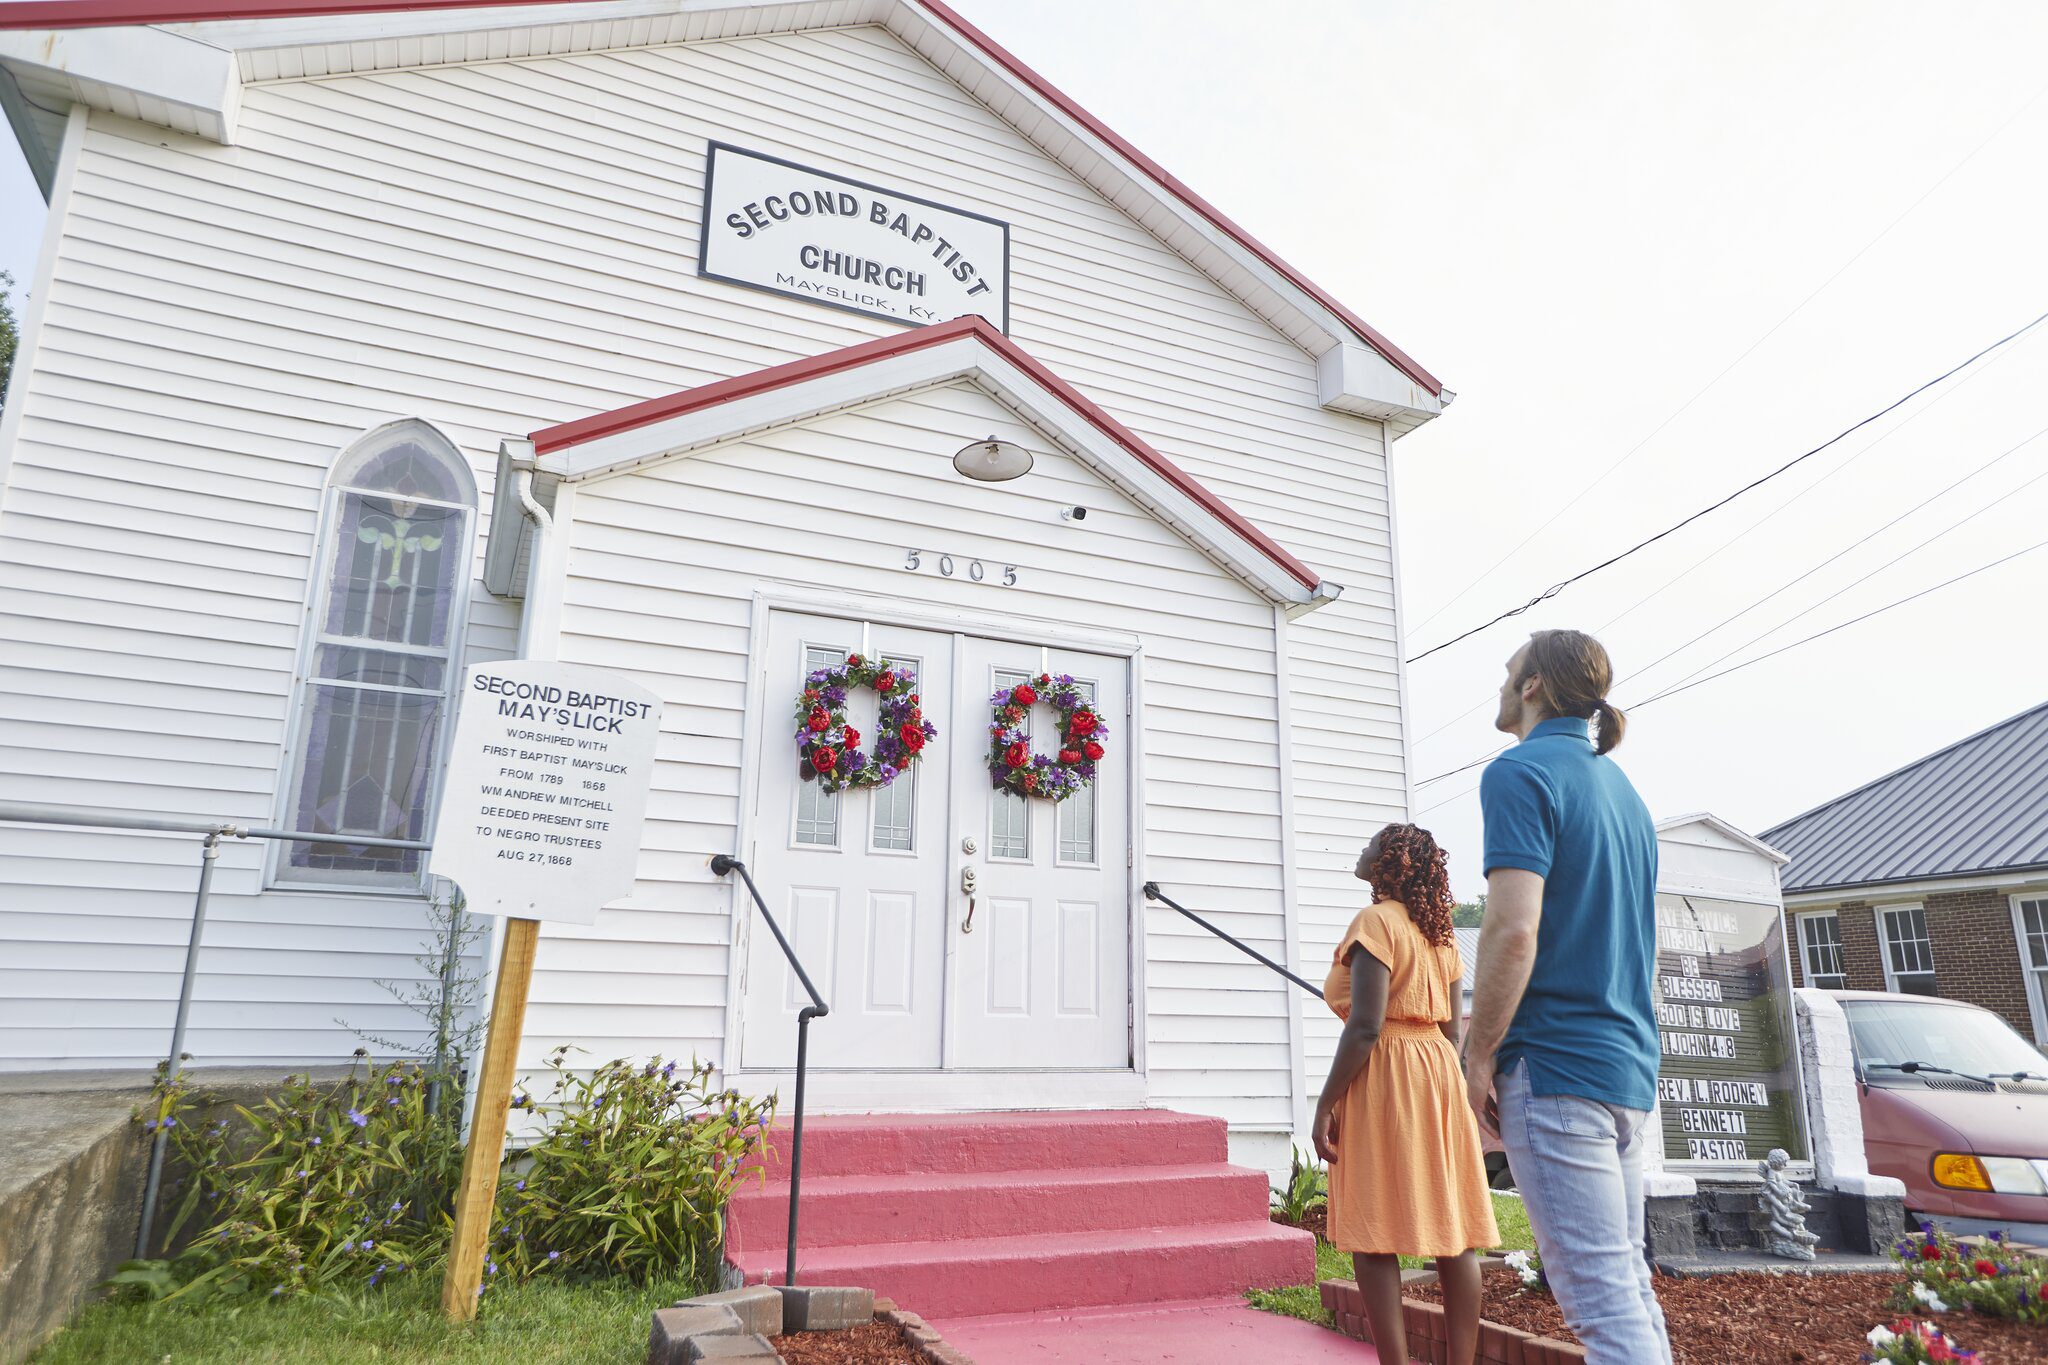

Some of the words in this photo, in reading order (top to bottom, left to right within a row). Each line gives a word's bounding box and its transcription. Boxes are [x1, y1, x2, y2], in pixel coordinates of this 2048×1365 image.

[726, 190, 860, 239] SECOND
[869, 200, 991, 299] BAPTIST
[800, 245, 926, 297] CHURCH
[776, 272, 896, 312] MAYSLICK,
[909, 304, 942, 322] KY.
[904, 549, 1018, 586] 5005
[473, 674, 562, 704] SECOND
[566, 691, 652, 720] BAPTIST
[506, 728, 575, 747] WORSHIPED
[578, 739, 608, 752] WITH
[482, 745, 517, 758] FIRST
[519, 750, 568, 766] BAPTIST
[499, 767, 534, 781] FROM
[540, 774, 564, 785] 1789
[582, 780, 606, 792] 1868
[481, 785, 503, 796] WM
[504, 788, 556, 803] ANDREW
[559, 796, 614, 812] MITCHELL
[480, 806, 530, 821] DEEDED
[532, 812, 583, 827] PRESENT
[585, 819, 610, 831] SITE
[476, 826, 492, 836] TO
[496, 828, 541, 842] NEGRO
[544, 834, 602, 850] TRUSTEES
[497, 849, 525, 861] AUG
[1682, 957, 1699, 977] BE
[1661, 976, 1721, 1001] BLESSED
[1658, 1004, 1686, 1026] GOD
[1689, 1006, 1703, 1027] IS
[1705, 1007, 1740, 1030] LOVE
[1672, 1033, 1708, 1056] JOHN
[1711, 1036, 1735, 1058] 4:8
[1657, 1079, 1690, 1101] REV.
[1695, 1080, 1709, 1102] L.
[1712, 1081, 1766, 1105] RODNEY
[1681, 1109, 1743, 1133] BENNETT
[1689, 1139, 1746, 1160] PASTOR
